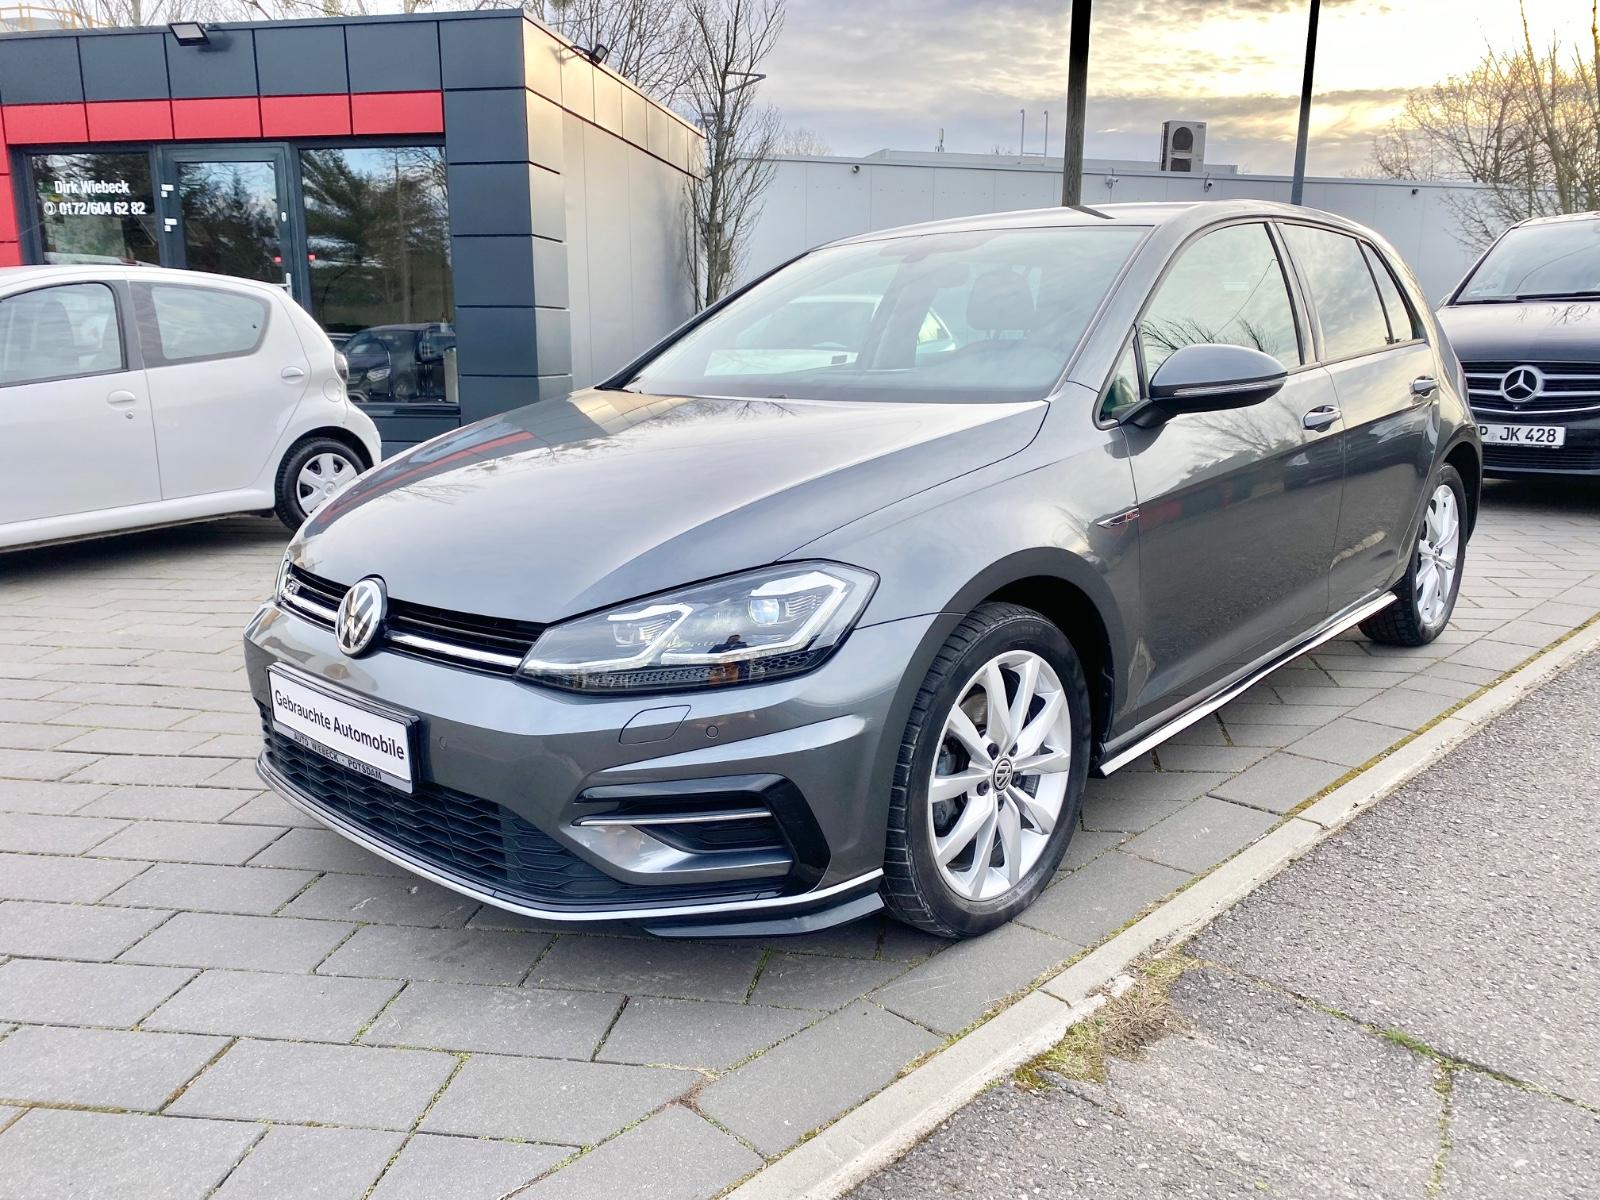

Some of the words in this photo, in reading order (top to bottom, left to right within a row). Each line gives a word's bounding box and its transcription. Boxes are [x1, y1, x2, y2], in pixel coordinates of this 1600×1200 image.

[54, 180, 78, 194] Dirk
[80, 180, 130, 194] Wiebeck
[59, 201, 112, 215] 0172/604
[114, 201, 129, 215] 62
[131, 201, 146, 215] 82
[1479, 425, 1489, 436] P
[1499, 426, 1521, 441] JK
[1525, 427, 1557, 443] 428
[274, 689, 331, 730] Gebrauchte
[333, 716, 405, 760] Automobile
[293, 732, 309, 746] AUTO
[347, 759, 382, 781] POTSDAM
